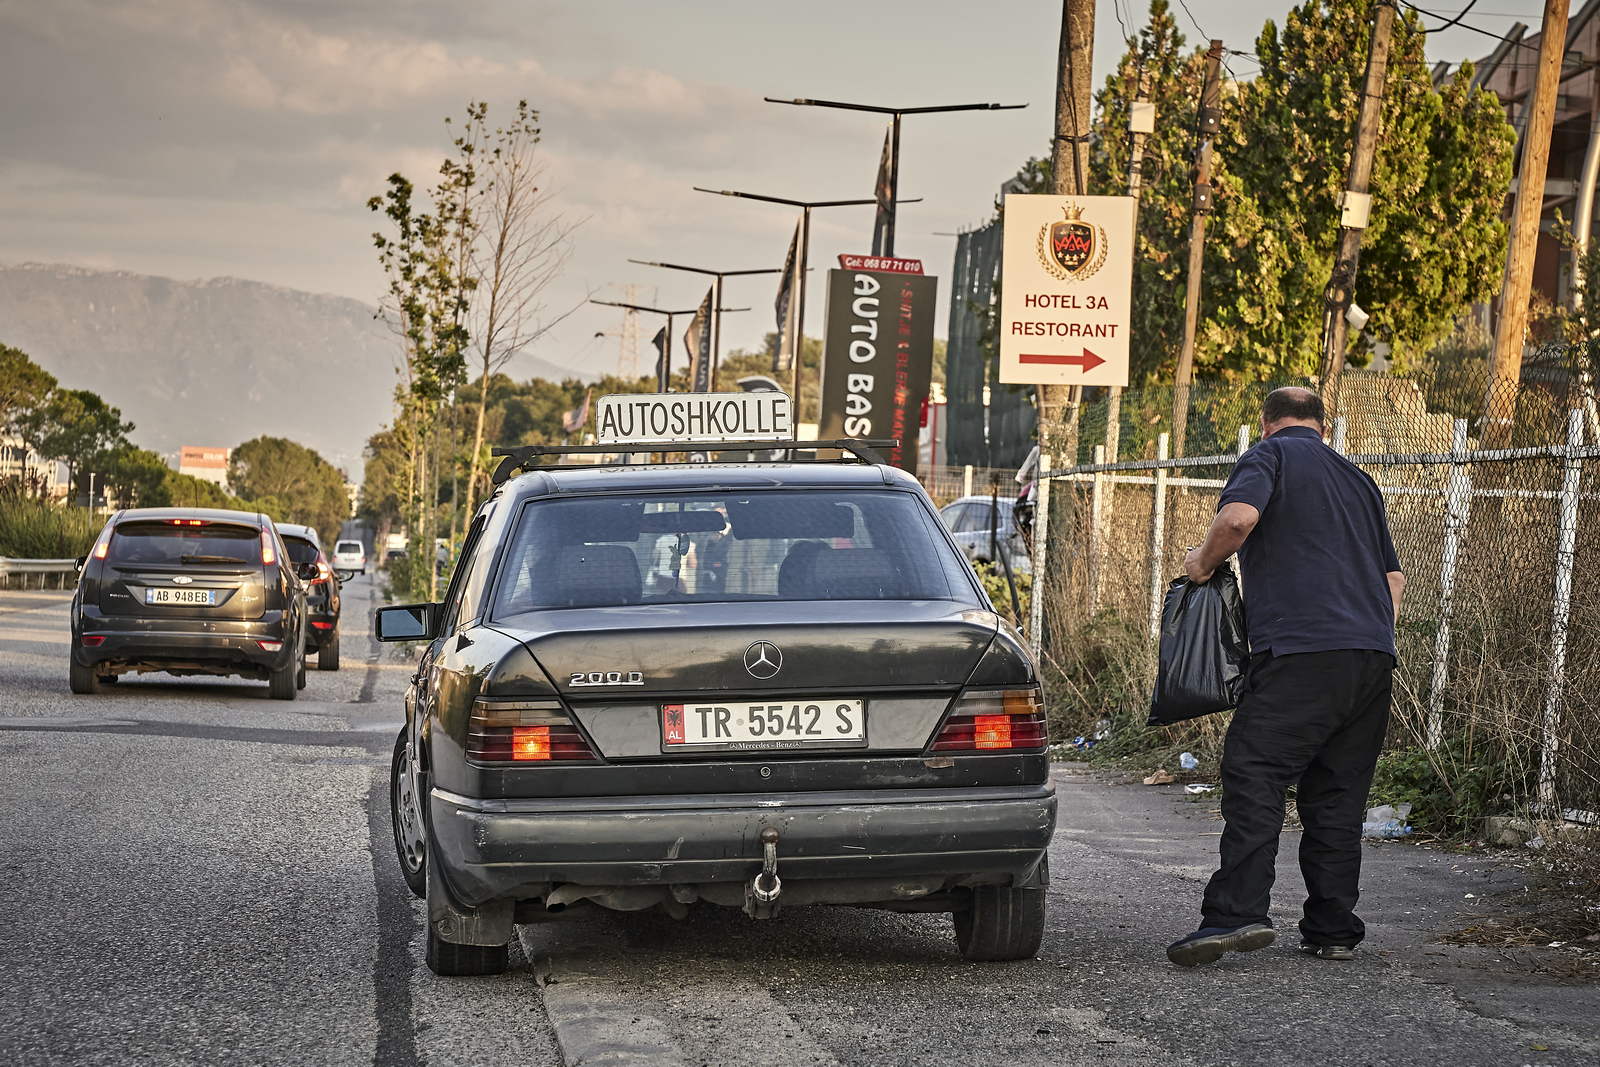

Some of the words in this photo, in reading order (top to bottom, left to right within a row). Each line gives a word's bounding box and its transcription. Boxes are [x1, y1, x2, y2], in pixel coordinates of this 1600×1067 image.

[880, 260, 892, 270] 67
[893, 261, 904, 271] 71
[904, 262, 921, 272] 010
[1025, 294, 1081, 309] HOTEL
[1086, 295, 1109, 310] 3A
[849, 273, 881, 364] AUTO
[1011, 321, 1119, 338] RESTORANT
[844, 373, 875, 440] BAS
[601, 398, 788, 438] AUTOSHKOLLE
[156, 590, 169, 601] AB
[570, 671, 622, 685] 200
[695, 707, 732, 738] TR
[748, 704, 822, 737] 5542
[835, 703, 853, 735] S
[668, 730, 683, 739] AL
